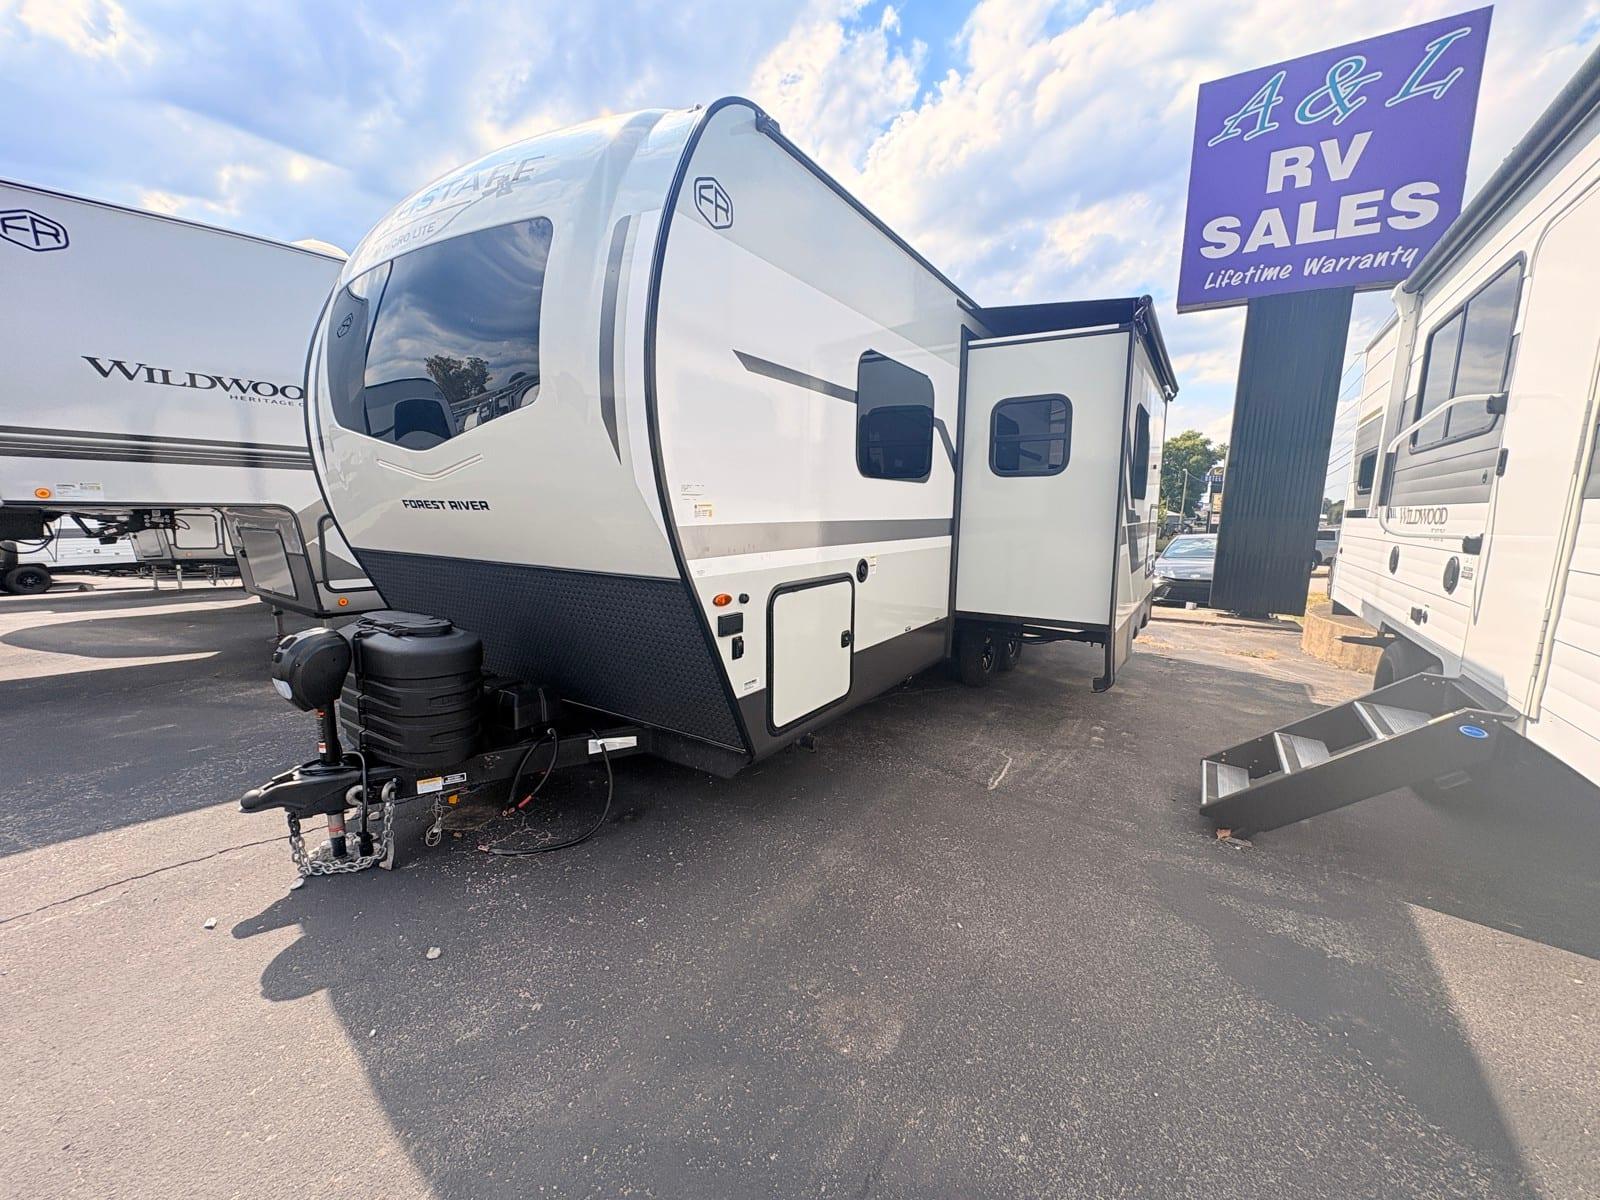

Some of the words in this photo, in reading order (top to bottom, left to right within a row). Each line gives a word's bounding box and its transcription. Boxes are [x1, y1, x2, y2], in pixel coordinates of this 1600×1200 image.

[1208, 70, 1287, 147] A
[1295, 55, 1382, 125] &
[1385, 26, 1472, 107] L
[1265, 130, 1373, 194] RV
[412, 220, 437, 241] LITE
[1199, 181, 1441, 260] SALES
[1204, 263, 1293, 290] Lifetime
[1303, 245, 1419, 278] Warranty
[229, 394, 295, 407] HERITAGE
[401, 499, 446, 510] FOREST
[447, 500, 490, 511] RIVER
[1399, 506, 1449, 525] WILDWOOD
